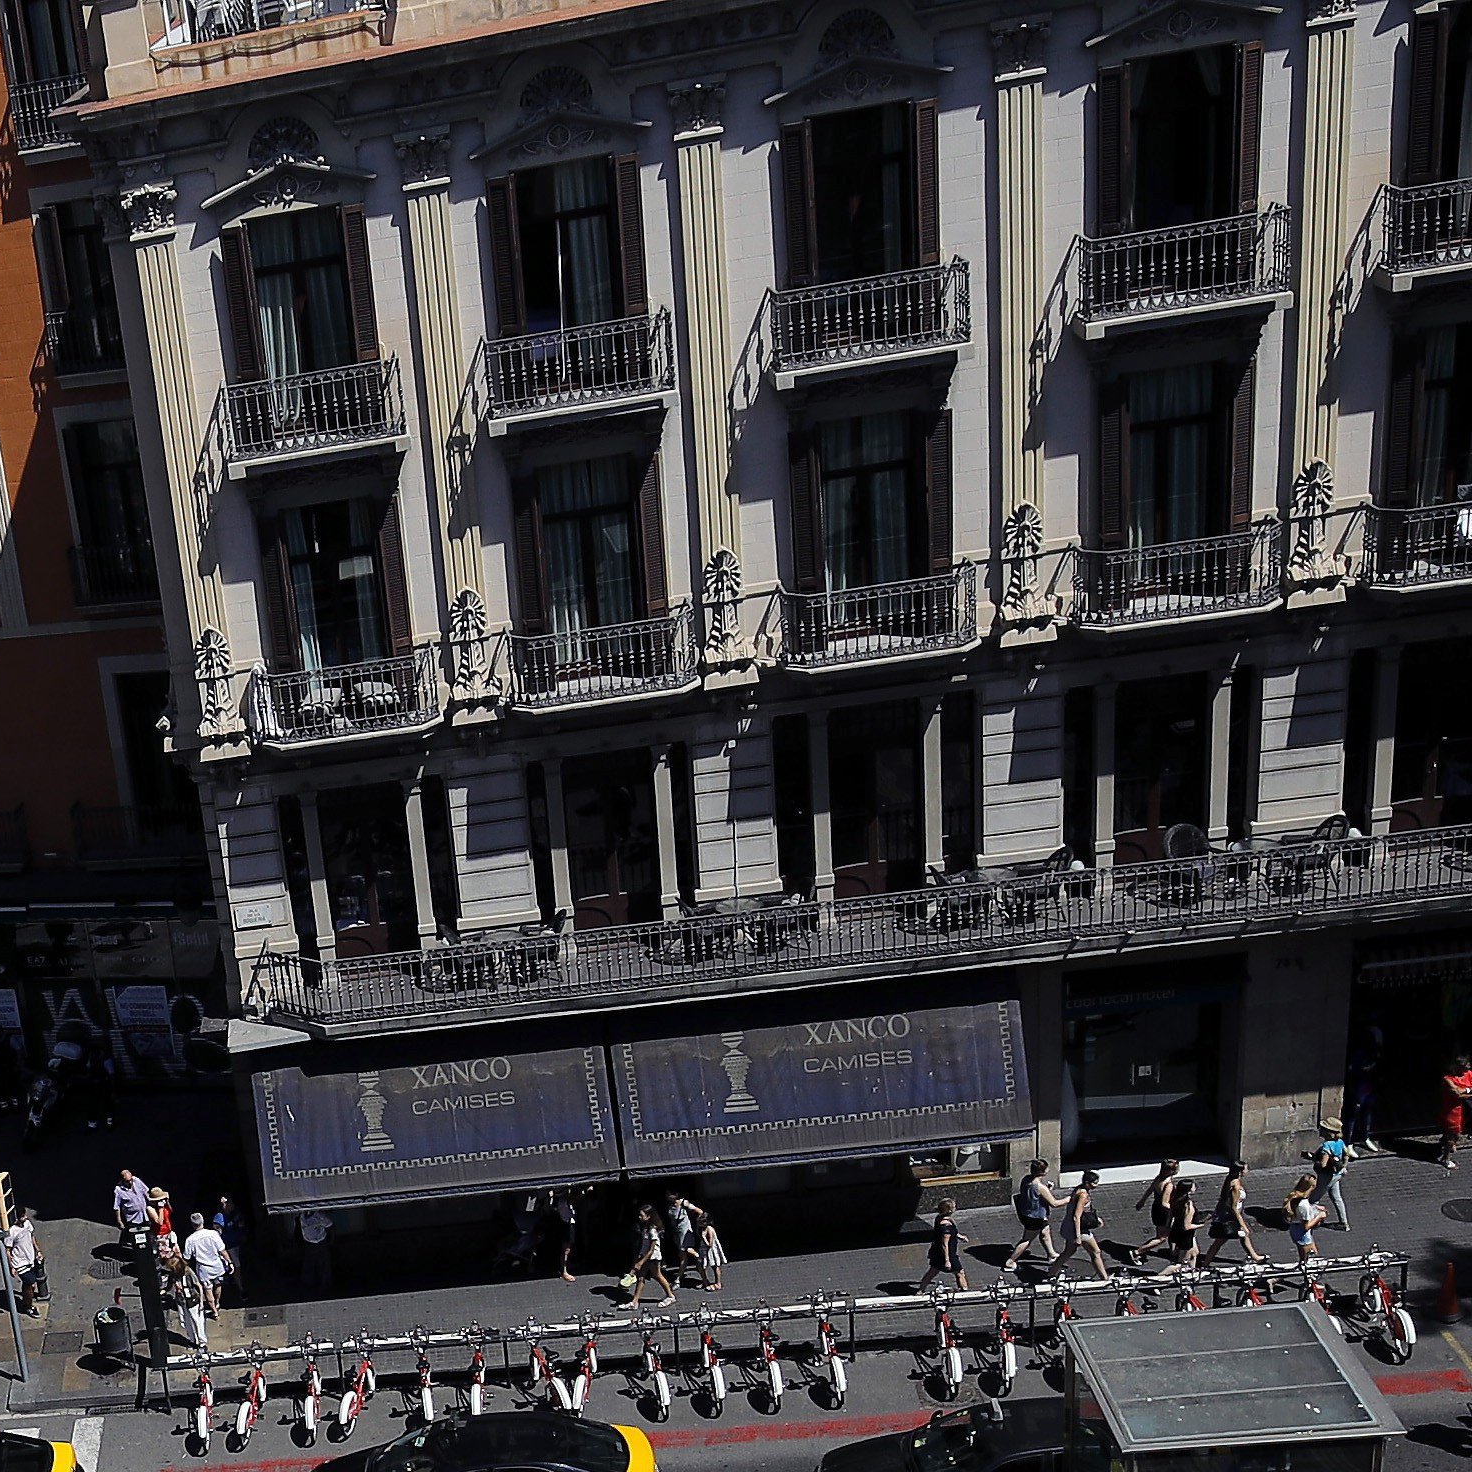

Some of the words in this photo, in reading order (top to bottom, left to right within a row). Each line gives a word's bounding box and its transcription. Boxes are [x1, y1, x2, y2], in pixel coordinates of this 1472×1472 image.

[803, 1014, 911, 1046] XANCO
[410, 1056, 512, 1090] XANCO
[803, 1050, 913, 1073] CAMISES
[412, 1090, 516, 1115] CAMISES
